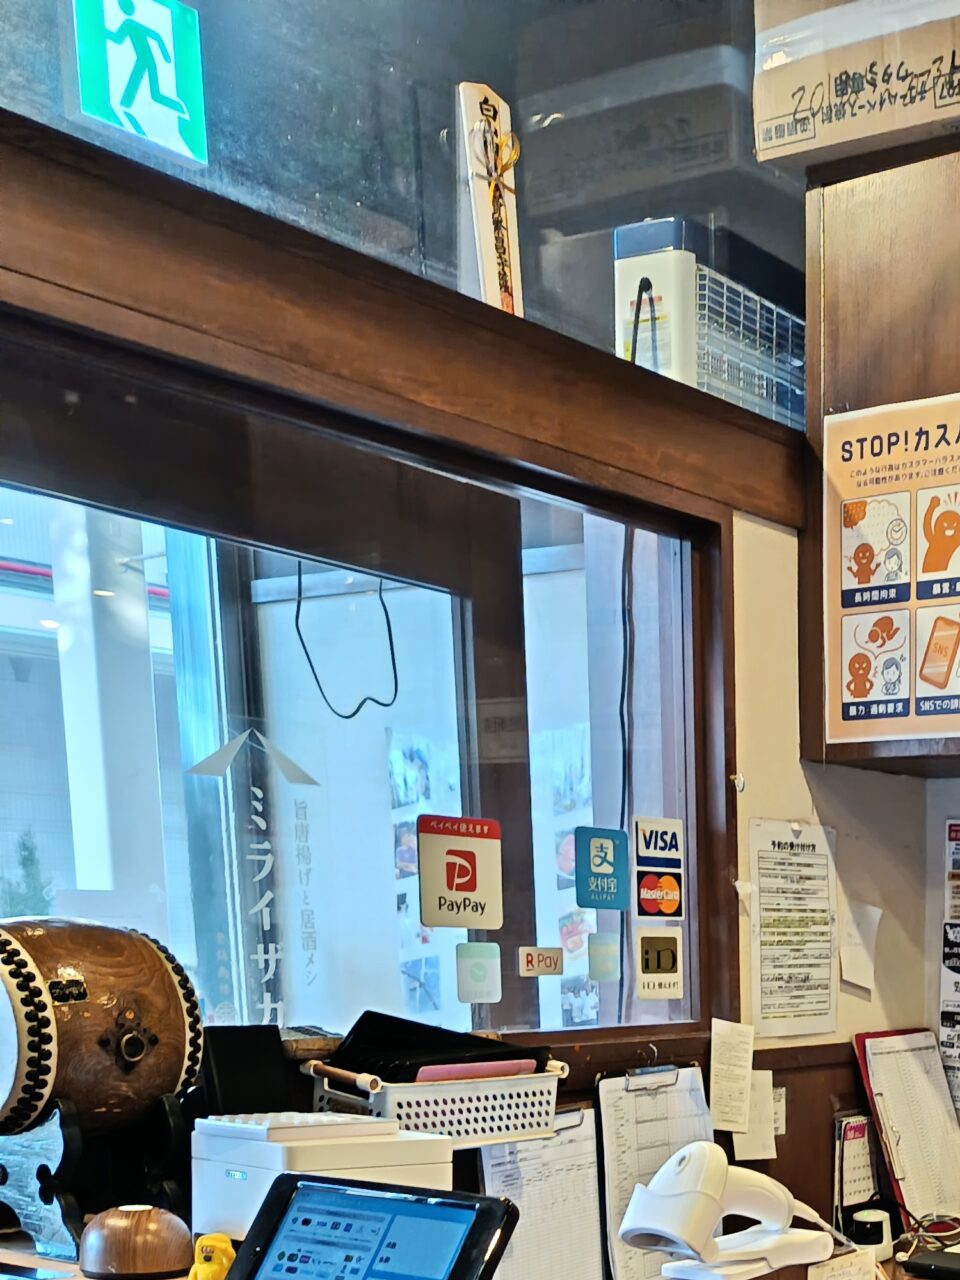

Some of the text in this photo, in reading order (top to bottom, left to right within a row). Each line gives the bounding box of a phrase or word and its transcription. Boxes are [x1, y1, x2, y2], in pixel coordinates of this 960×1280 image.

[854, 588, 897, 603] 長時間拘束
[932, 642, 949, 658] SNS
[430, 821, 489, 835] ペイペイ使えます
[641, 829, 680, 852] VISA
[640, 887, 680, 900] MasterCard
[246, 786, 285, 1029] ミライザカ
[438, 896, 487, 915] PayPay
[537, 953, 559, 971] Pay
[645, 947, 676, 971] iD
